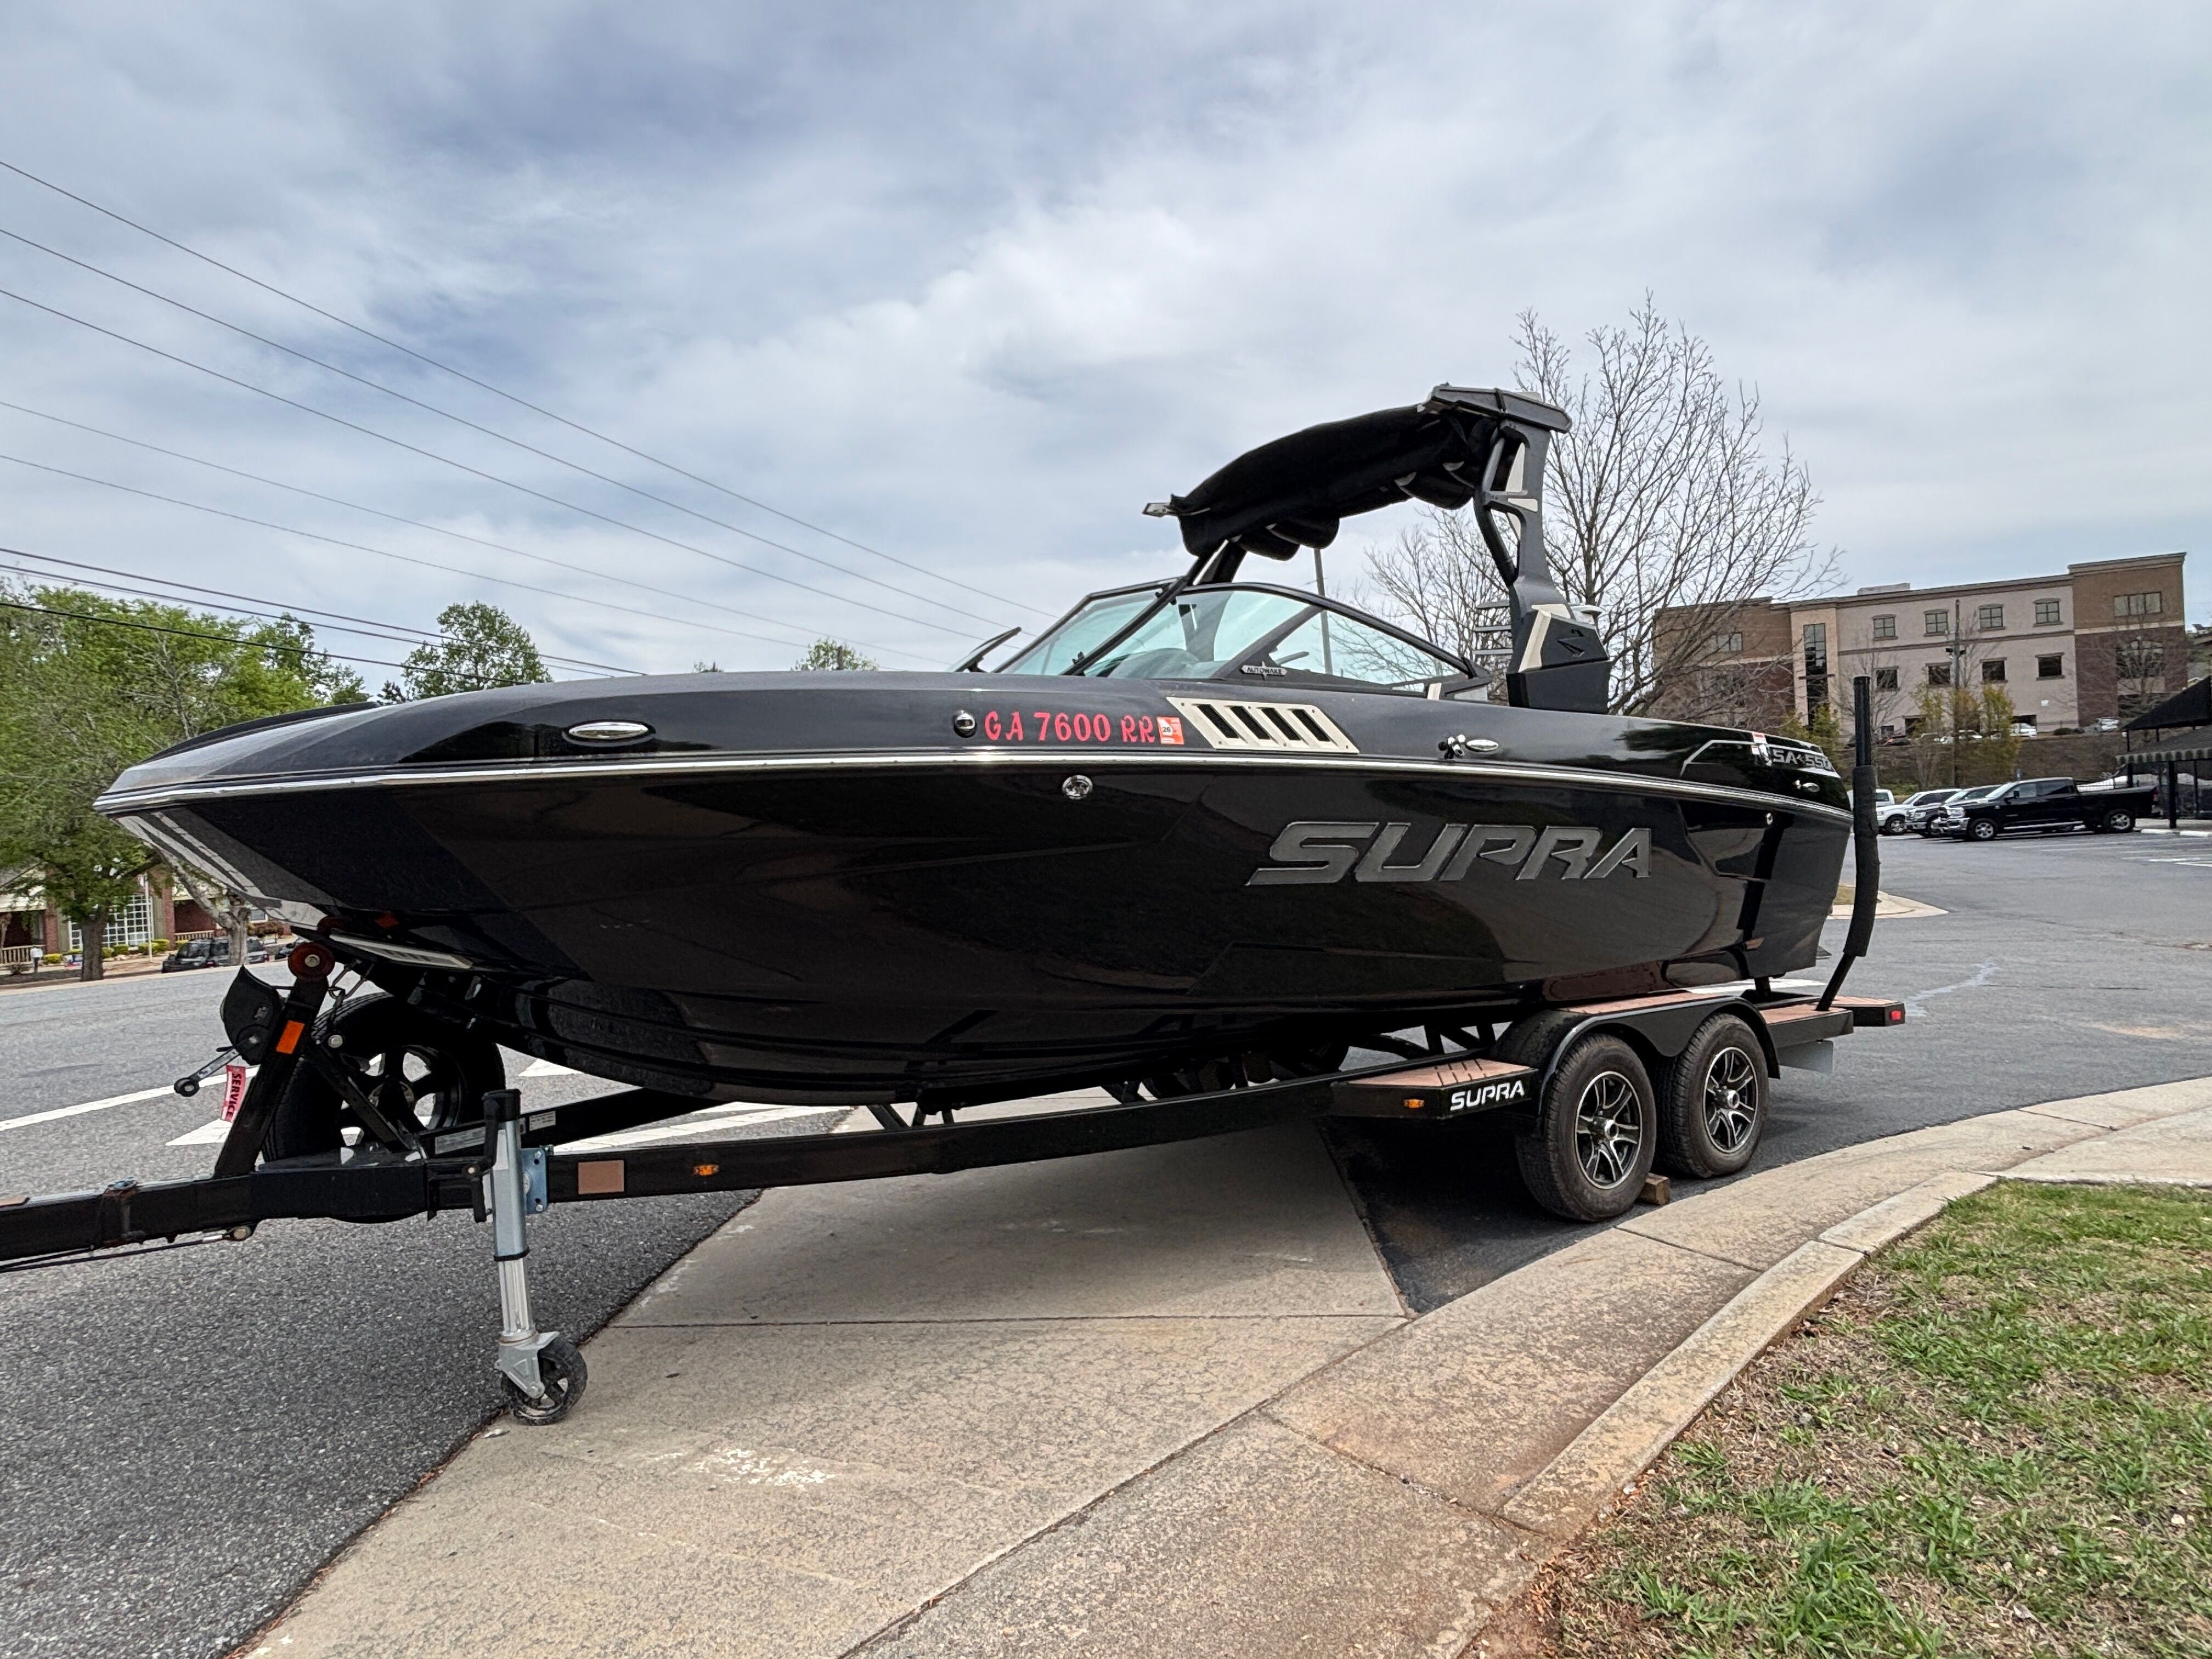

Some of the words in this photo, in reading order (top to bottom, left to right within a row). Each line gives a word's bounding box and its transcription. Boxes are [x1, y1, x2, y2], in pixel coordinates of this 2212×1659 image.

[984, 711, 1024, 741] GA
[1033, 712, 1110, 742] 7600
[1121, 715, 1155, 743] RR
[1245, 821, 1651, 885] SUPRA
[225, 1073, 242, 1116] SERVICE
[1450, 1080, 1525, 1111] SUPRA
